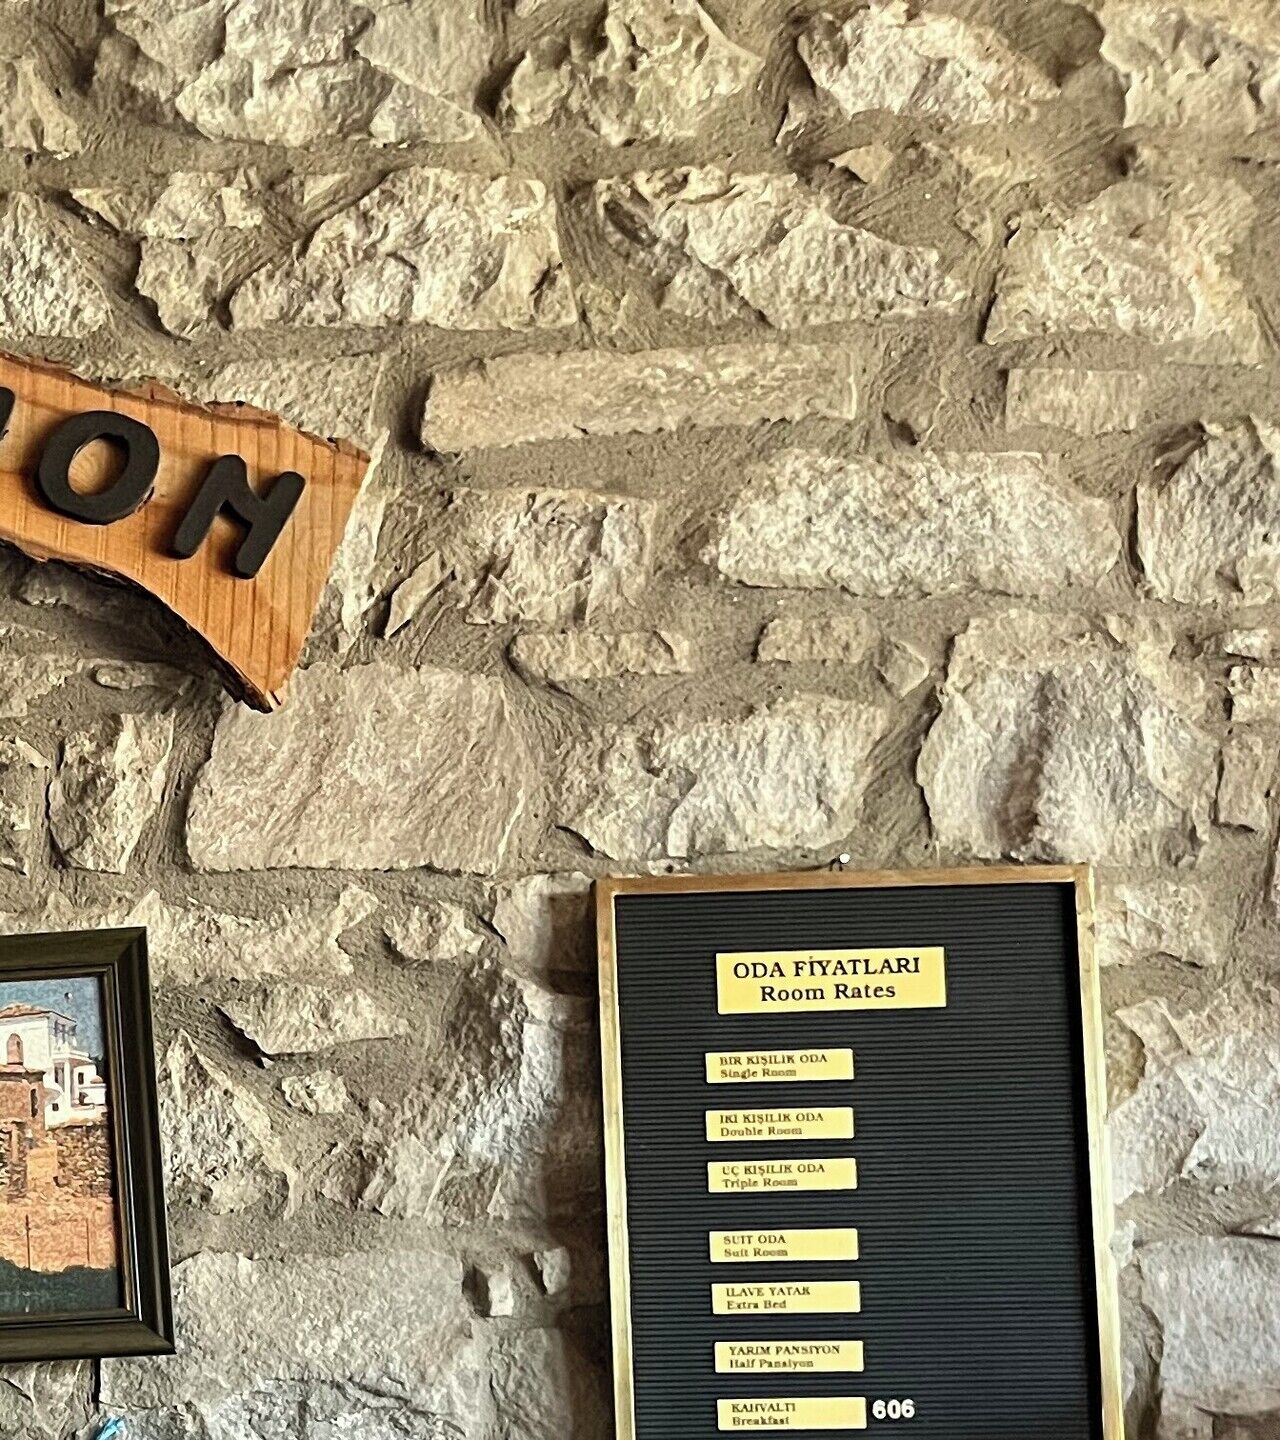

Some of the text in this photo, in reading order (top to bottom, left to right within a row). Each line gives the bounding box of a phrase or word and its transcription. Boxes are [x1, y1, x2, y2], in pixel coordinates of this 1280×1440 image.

[733, 955, 920, 979] ODA FİYATLARI
[760, 983, 896, 1002] Room Rates
[799, 1054, 828, 1063] ODA
[720, 1068, 796, 1079] Single Room
[795, 1112, 824, 1121] ODA
[720, 1126, 802, 1137] Double Room
[798, 1164, 825, 1173] ODA
[722, 1177, 798, 1190] Triple Room
[758, 1234, 786, 1244] ODA
[724, 1247, 788, 1257] Suit Room
[769, 1286, 810, 1296] YATAK
[727, 1299, 787, 1310] Extra Bed
[729, 1345, 770, 1355] YARIM
[730, 1358, 756, 1368] Half
[731, 1398, 915, 1420] KAHVALTI 606
[732, 1416, 789, 1426] Breakfast
